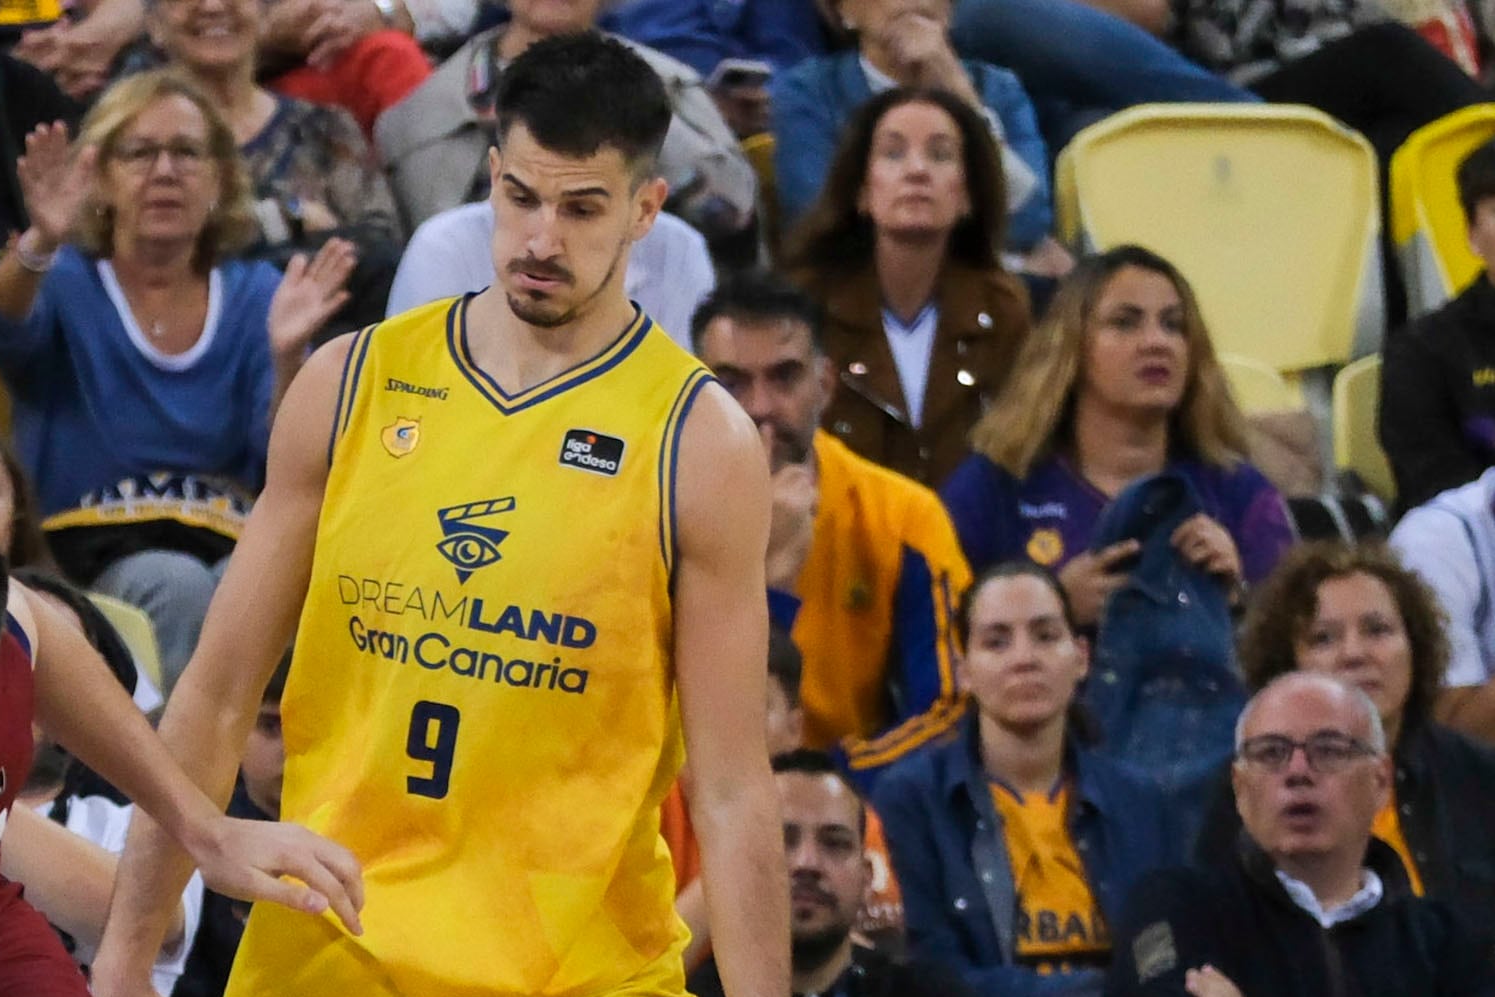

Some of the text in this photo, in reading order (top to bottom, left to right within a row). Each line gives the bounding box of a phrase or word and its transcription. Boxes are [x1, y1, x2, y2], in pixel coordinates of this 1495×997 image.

[384, 378, 450, 401] SPALDING
[563, 451, 617, 471] endesa
[566, 438, 592, 454] liga
[338, 575, 597, 650] DREAMLAND
[349, 616, 590, 694] Gran Canaria
[406, 700, 461, 800] 9
